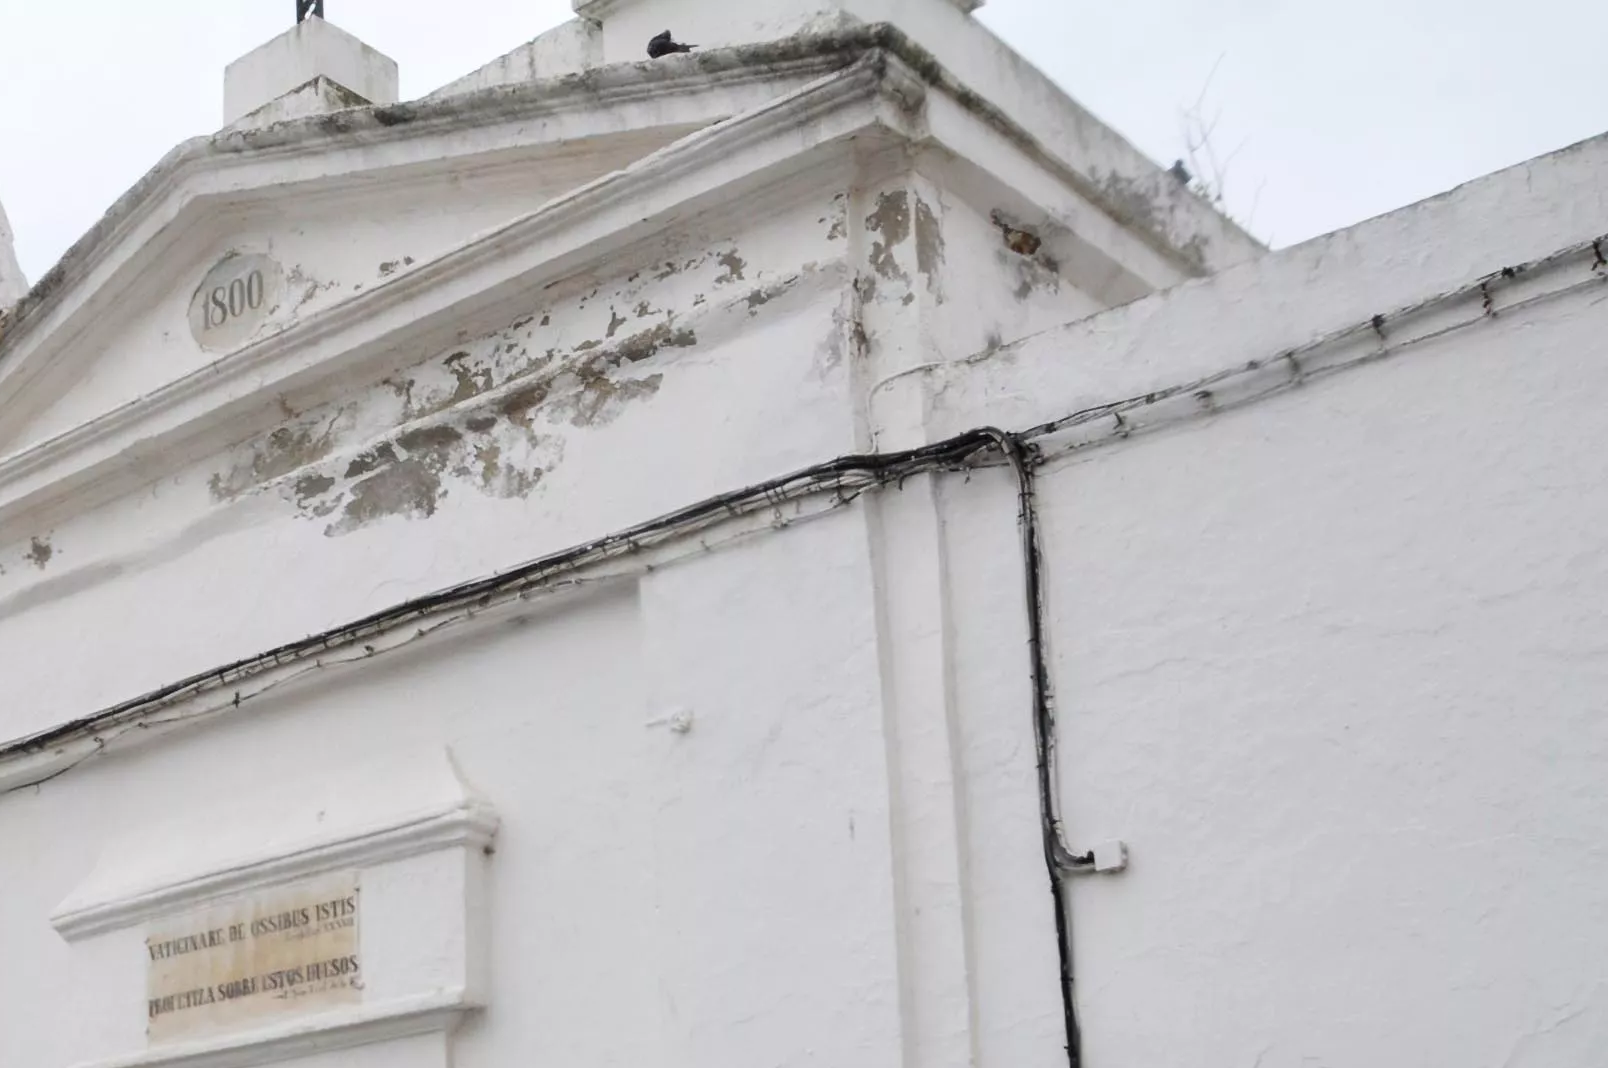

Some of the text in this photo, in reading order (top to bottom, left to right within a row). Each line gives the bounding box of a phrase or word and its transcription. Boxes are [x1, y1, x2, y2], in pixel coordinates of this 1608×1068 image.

[202, 270, 264, 331] 1800
[149, 928, 225, 961] VATICINARE
[229, 922, 246, 942] DE
[251, 907, 309, 938] OSSIBUS
[315, 896, 356, 922] ISTIS
[218, 976, 260, 1002] SOBRE
[262, 966, 304, 992] ESTOS
[306, 955, 359, 982] HUESOS
